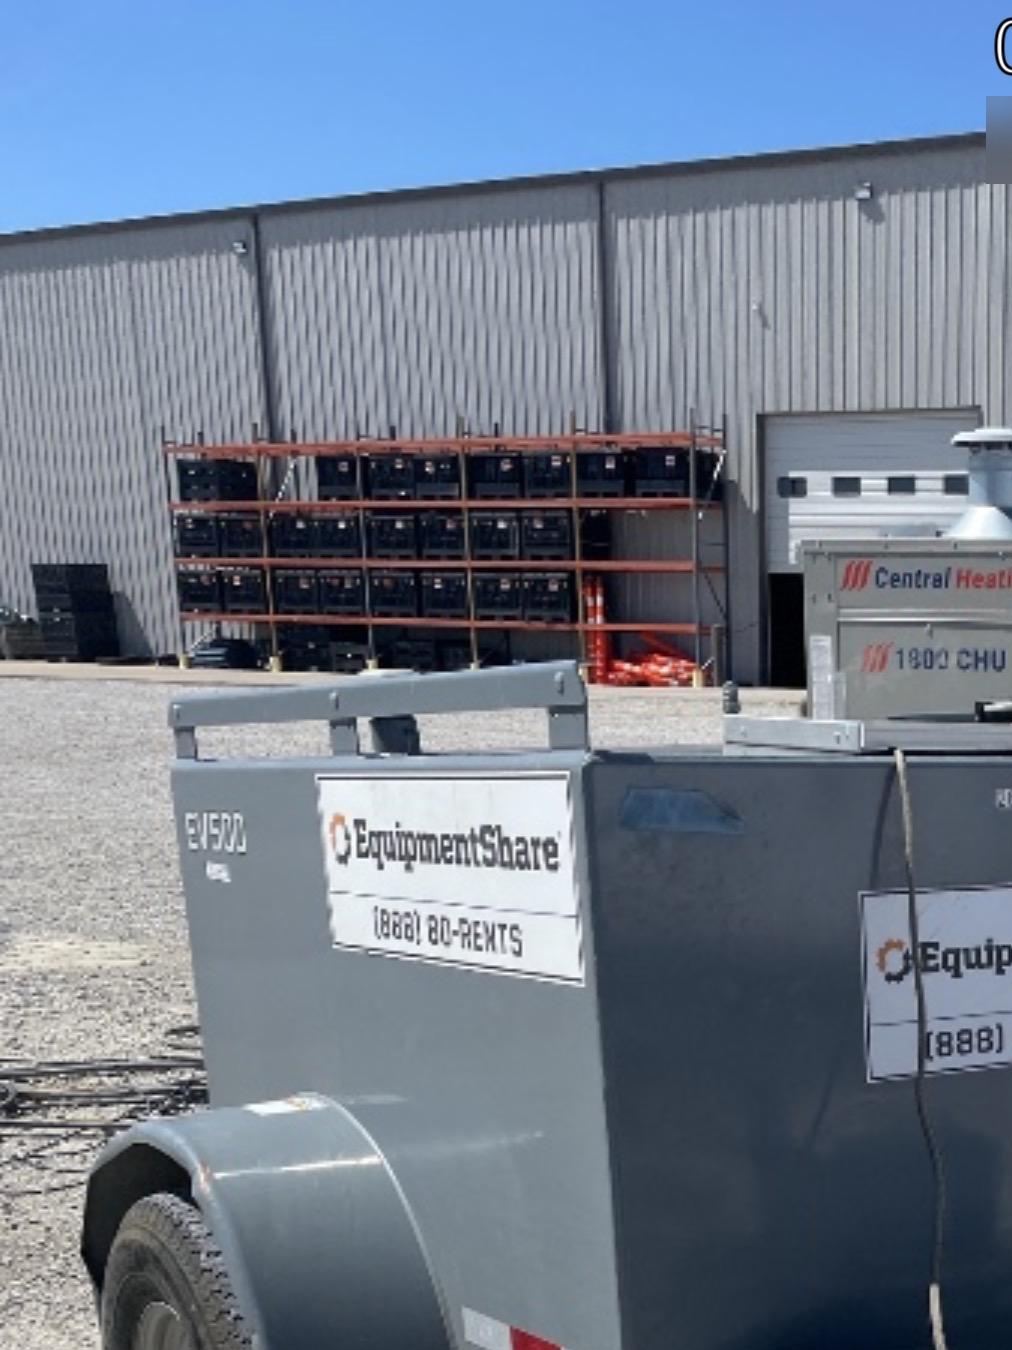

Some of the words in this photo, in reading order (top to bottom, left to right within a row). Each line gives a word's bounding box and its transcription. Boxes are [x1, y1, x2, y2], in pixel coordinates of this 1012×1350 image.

[874, 566, 951, 589] Central
[956, 648, 1007, 671] CHU
[353, 818, 559, 873] EquipmentShare
[373, 904, 421, 946] (888)
[427, 914, 523, 958] 80-RENTS
[925, 1023, 1003, 1061] (888)
